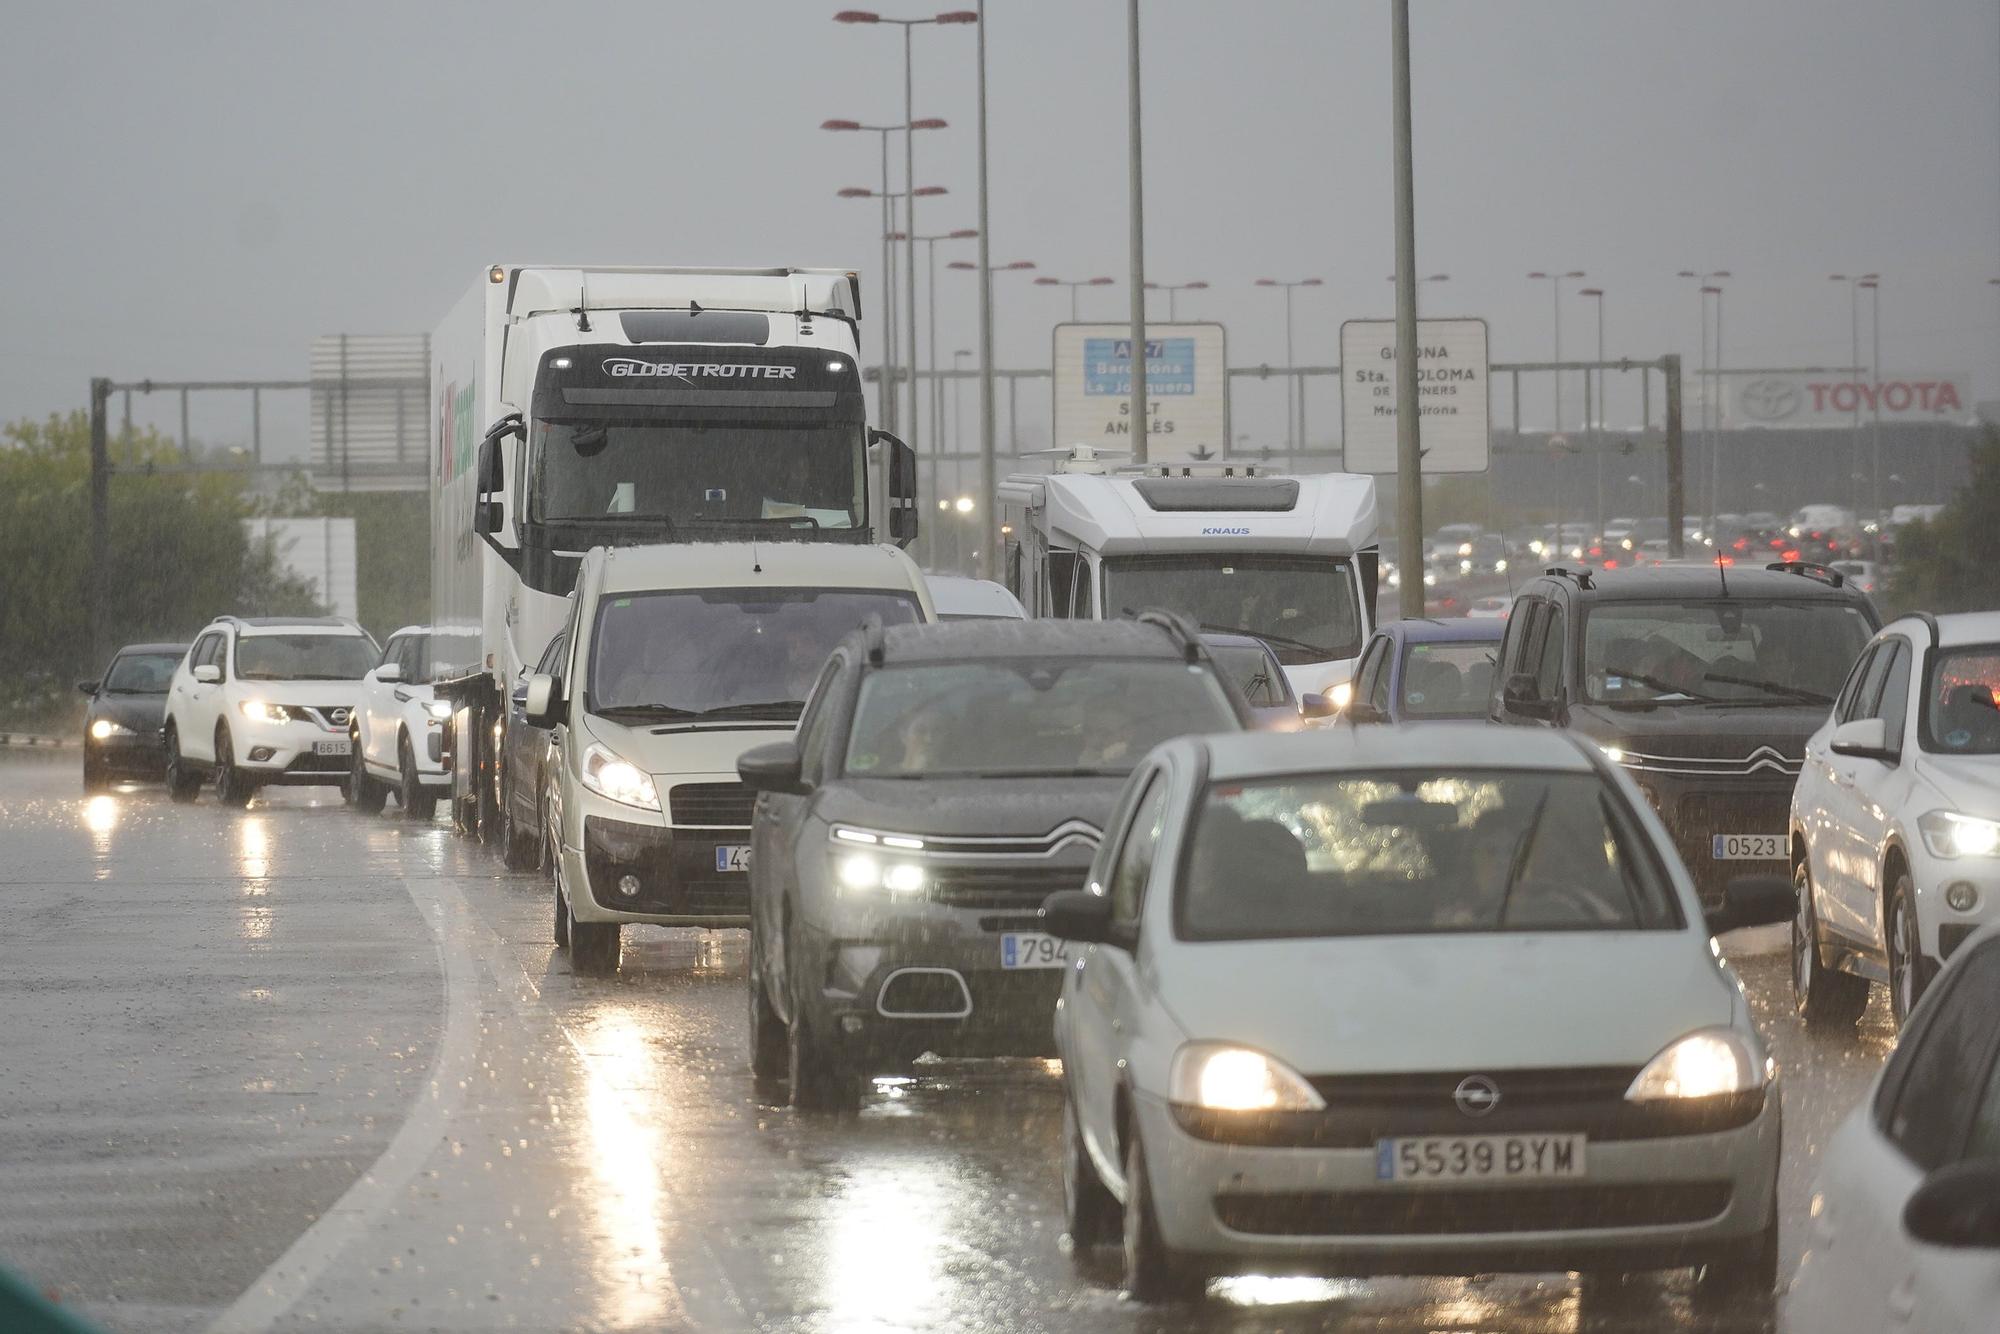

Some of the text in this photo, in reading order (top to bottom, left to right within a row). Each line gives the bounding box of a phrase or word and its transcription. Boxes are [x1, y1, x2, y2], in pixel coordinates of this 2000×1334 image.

[608, 361, 797, 380] GLOBETROTTER
[1355, 369, 1389, 383] Sta.
[1372, 386, 1390, 397] DE
[1806, 381, 1962, 412] TOYOTA
[1201, 527, 1251, 535] KNAUS
[319, 743, 346, 754] 6615
[1727, 838, 1776, 856] 0523
[1400, 1138, 1573, 1176] 5539 BYM
